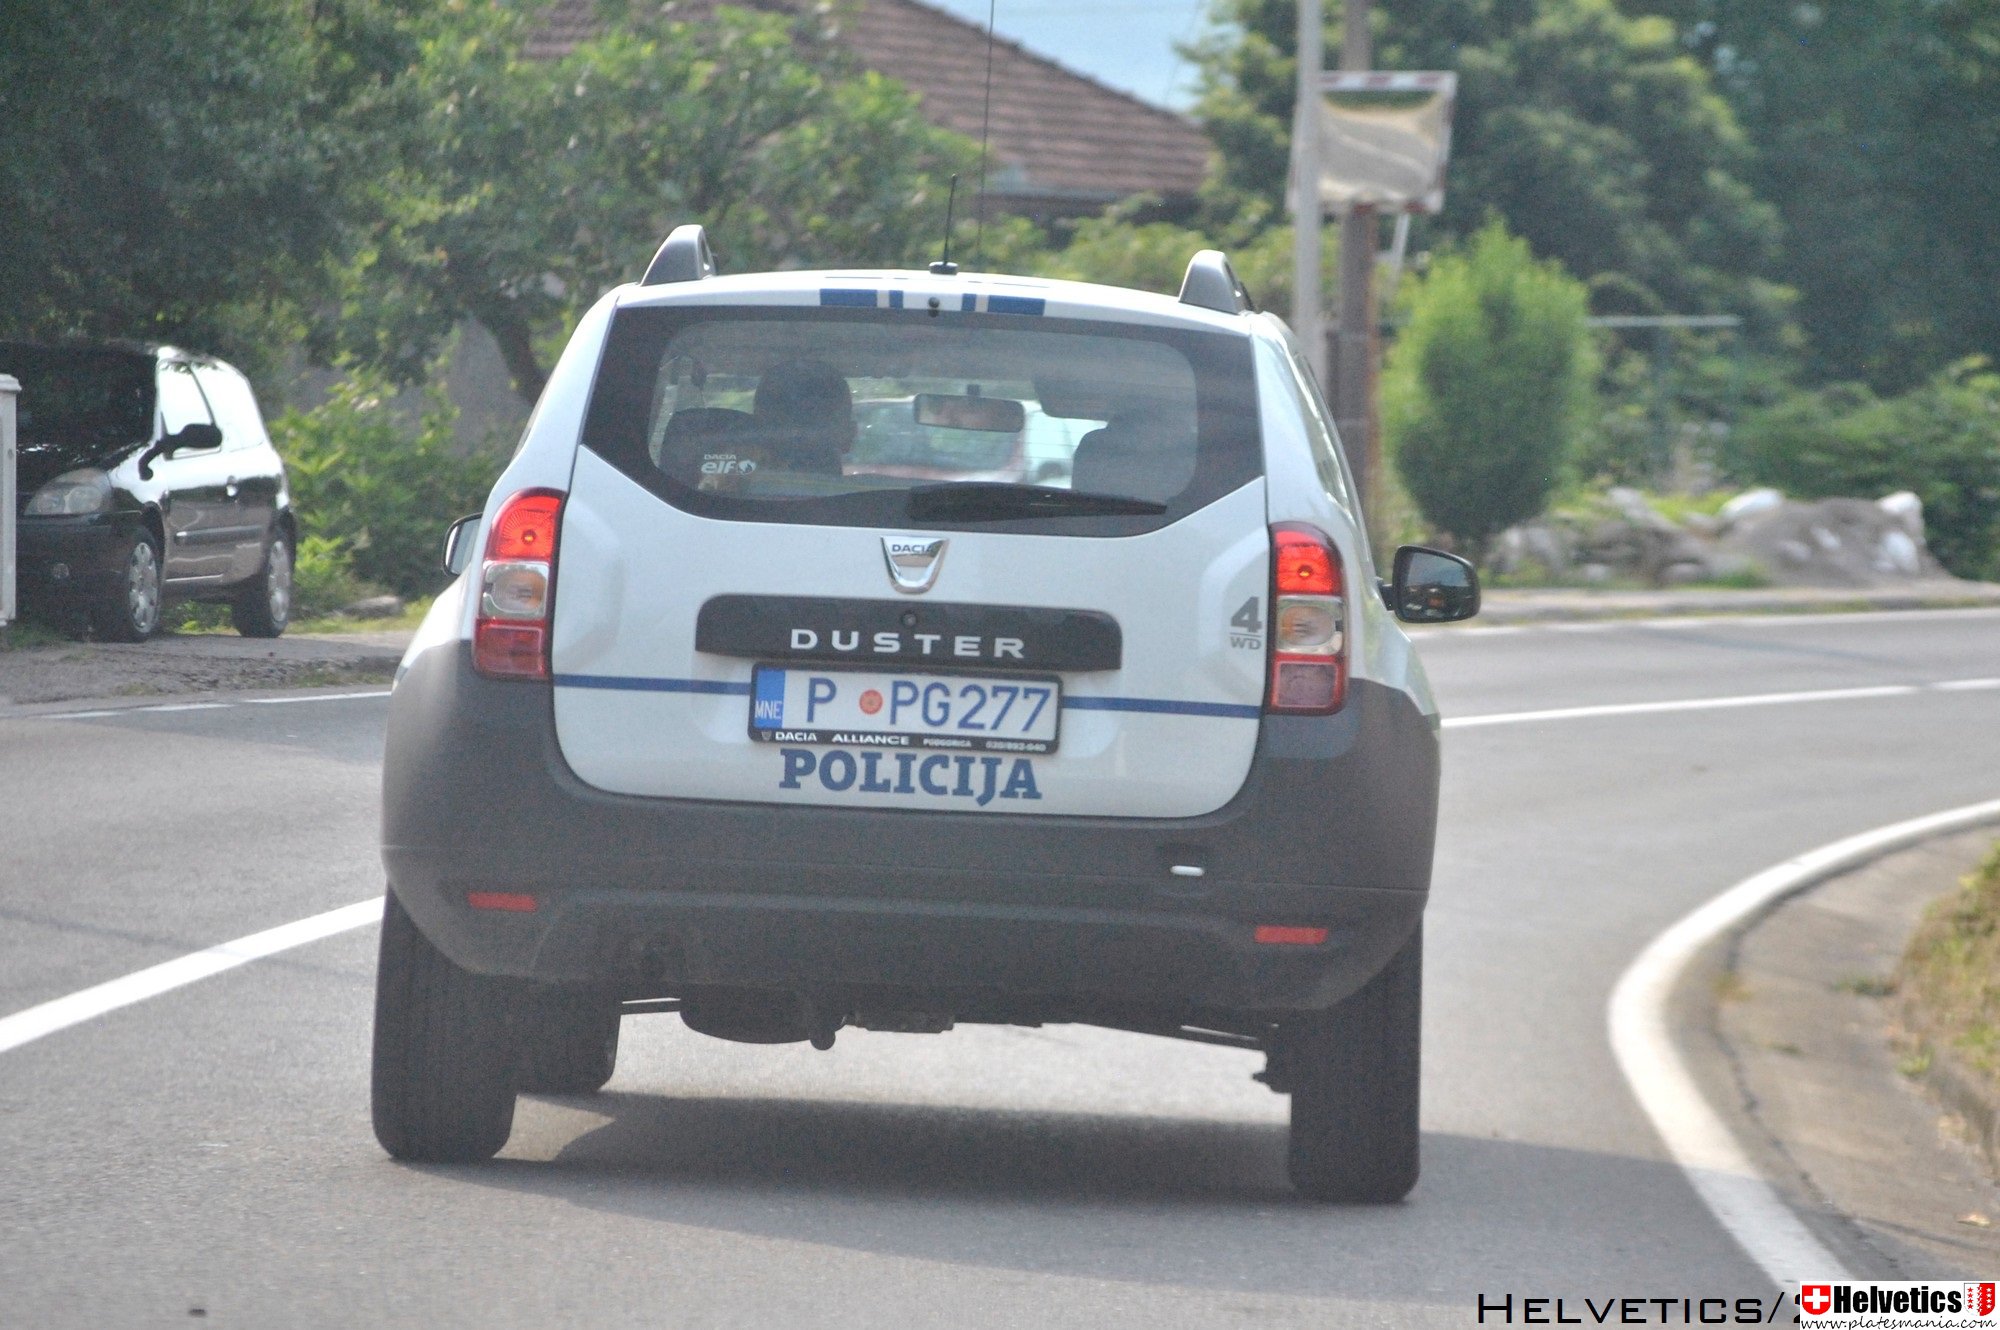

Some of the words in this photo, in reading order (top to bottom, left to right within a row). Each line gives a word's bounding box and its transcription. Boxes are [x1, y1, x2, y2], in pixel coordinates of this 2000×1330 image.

[701, 461, 737, 474] elf
[1231, 596, 1262, 633] 4
[790, 629, 1025, 659] DUSTER
[1230, 636, 1262, 650] WD
[755, 700, 782, 721] MNE
[775, 731, 817, 742] DACIA
[832, 733, 909, 746] ALLIANCE
[779, 748, 1042, 806] POLICIJA
